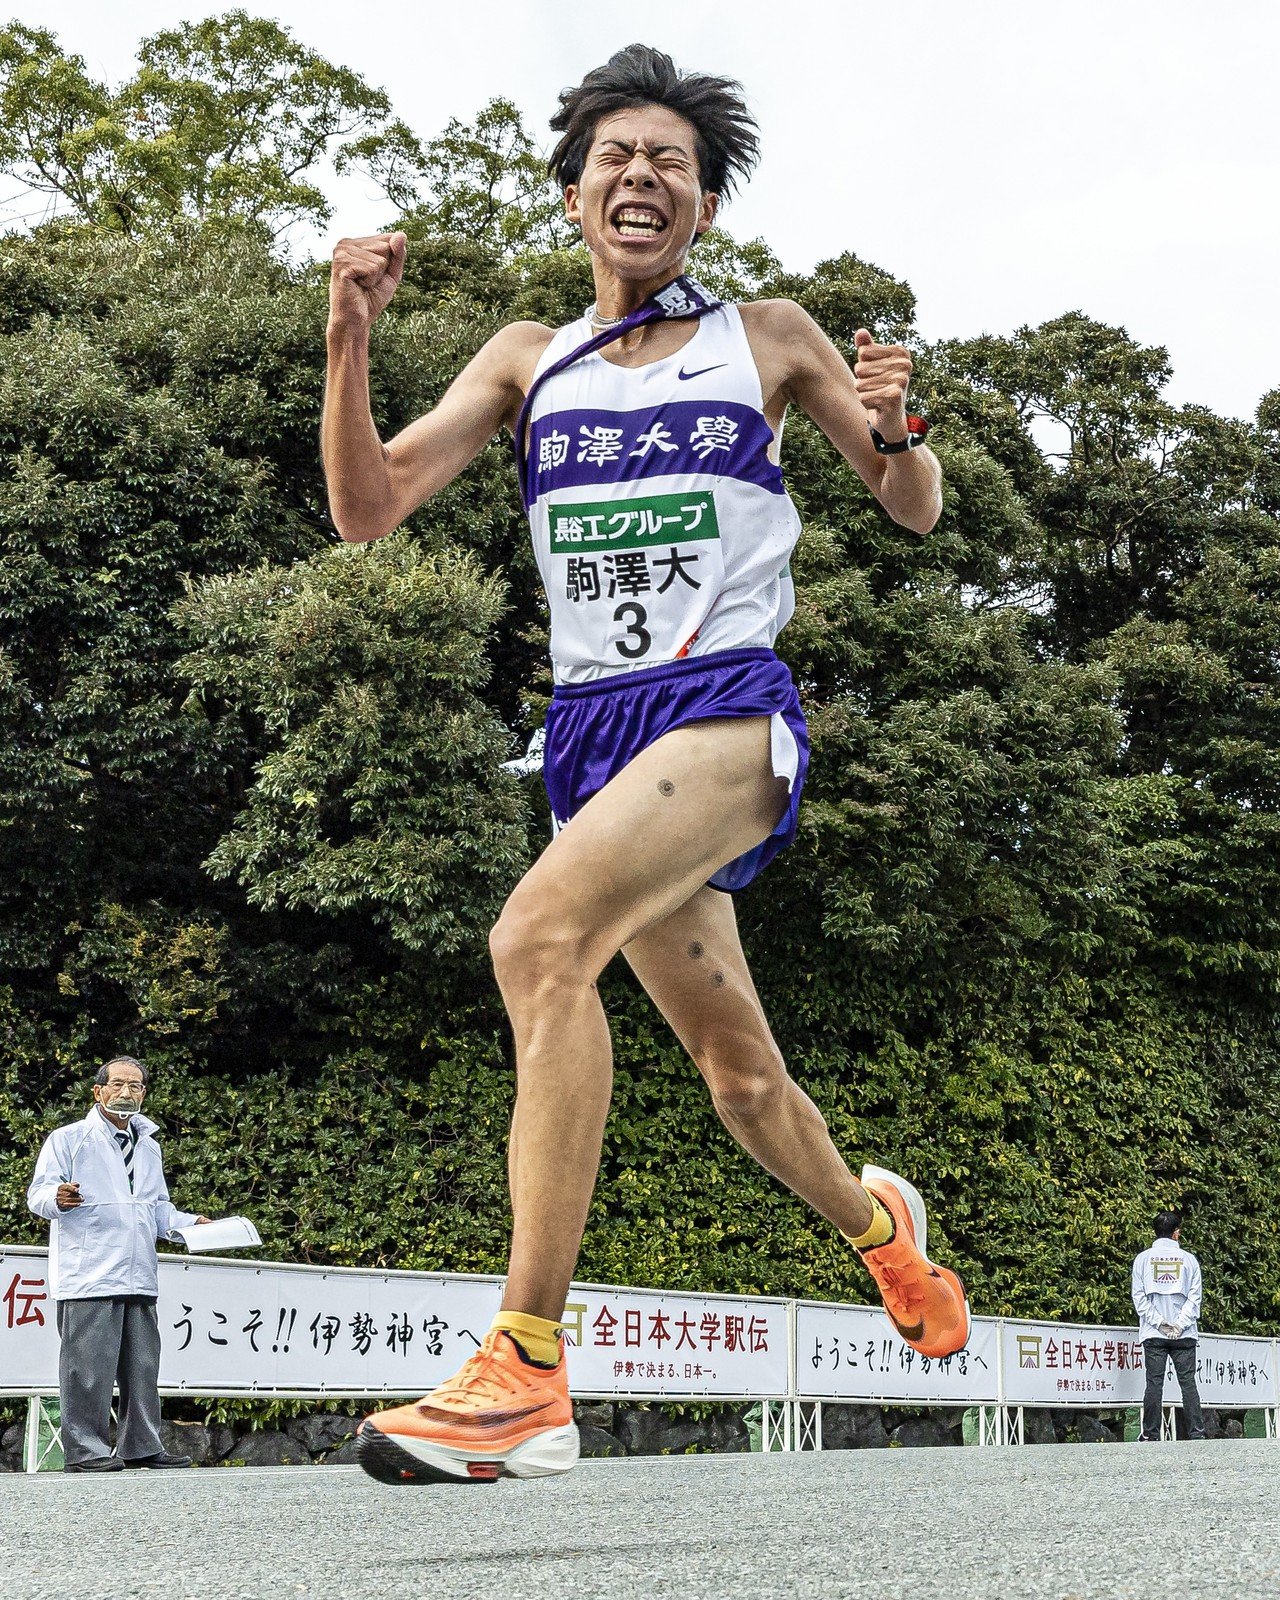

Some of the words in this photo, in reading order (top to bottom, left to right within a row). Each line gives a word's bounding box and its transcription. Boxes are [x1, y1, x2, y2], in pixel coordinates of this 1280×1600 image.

[538, 416, 739, 473] 駒澤大學
[554, 502, 708, 543] 長谷工グループ
[566, 547, 702, 603] 駒澤大
[613, 601, 652, 659] 3
[2, 1273, 48, 1329] 伝
[592, 1304, 769, 1354] 全日本大学駅伝
[1044, 1336, 1143, 1371] 全日本大学駅伝
[613, 1360, 717, 1380] 伊勢で決まる、日本一。
